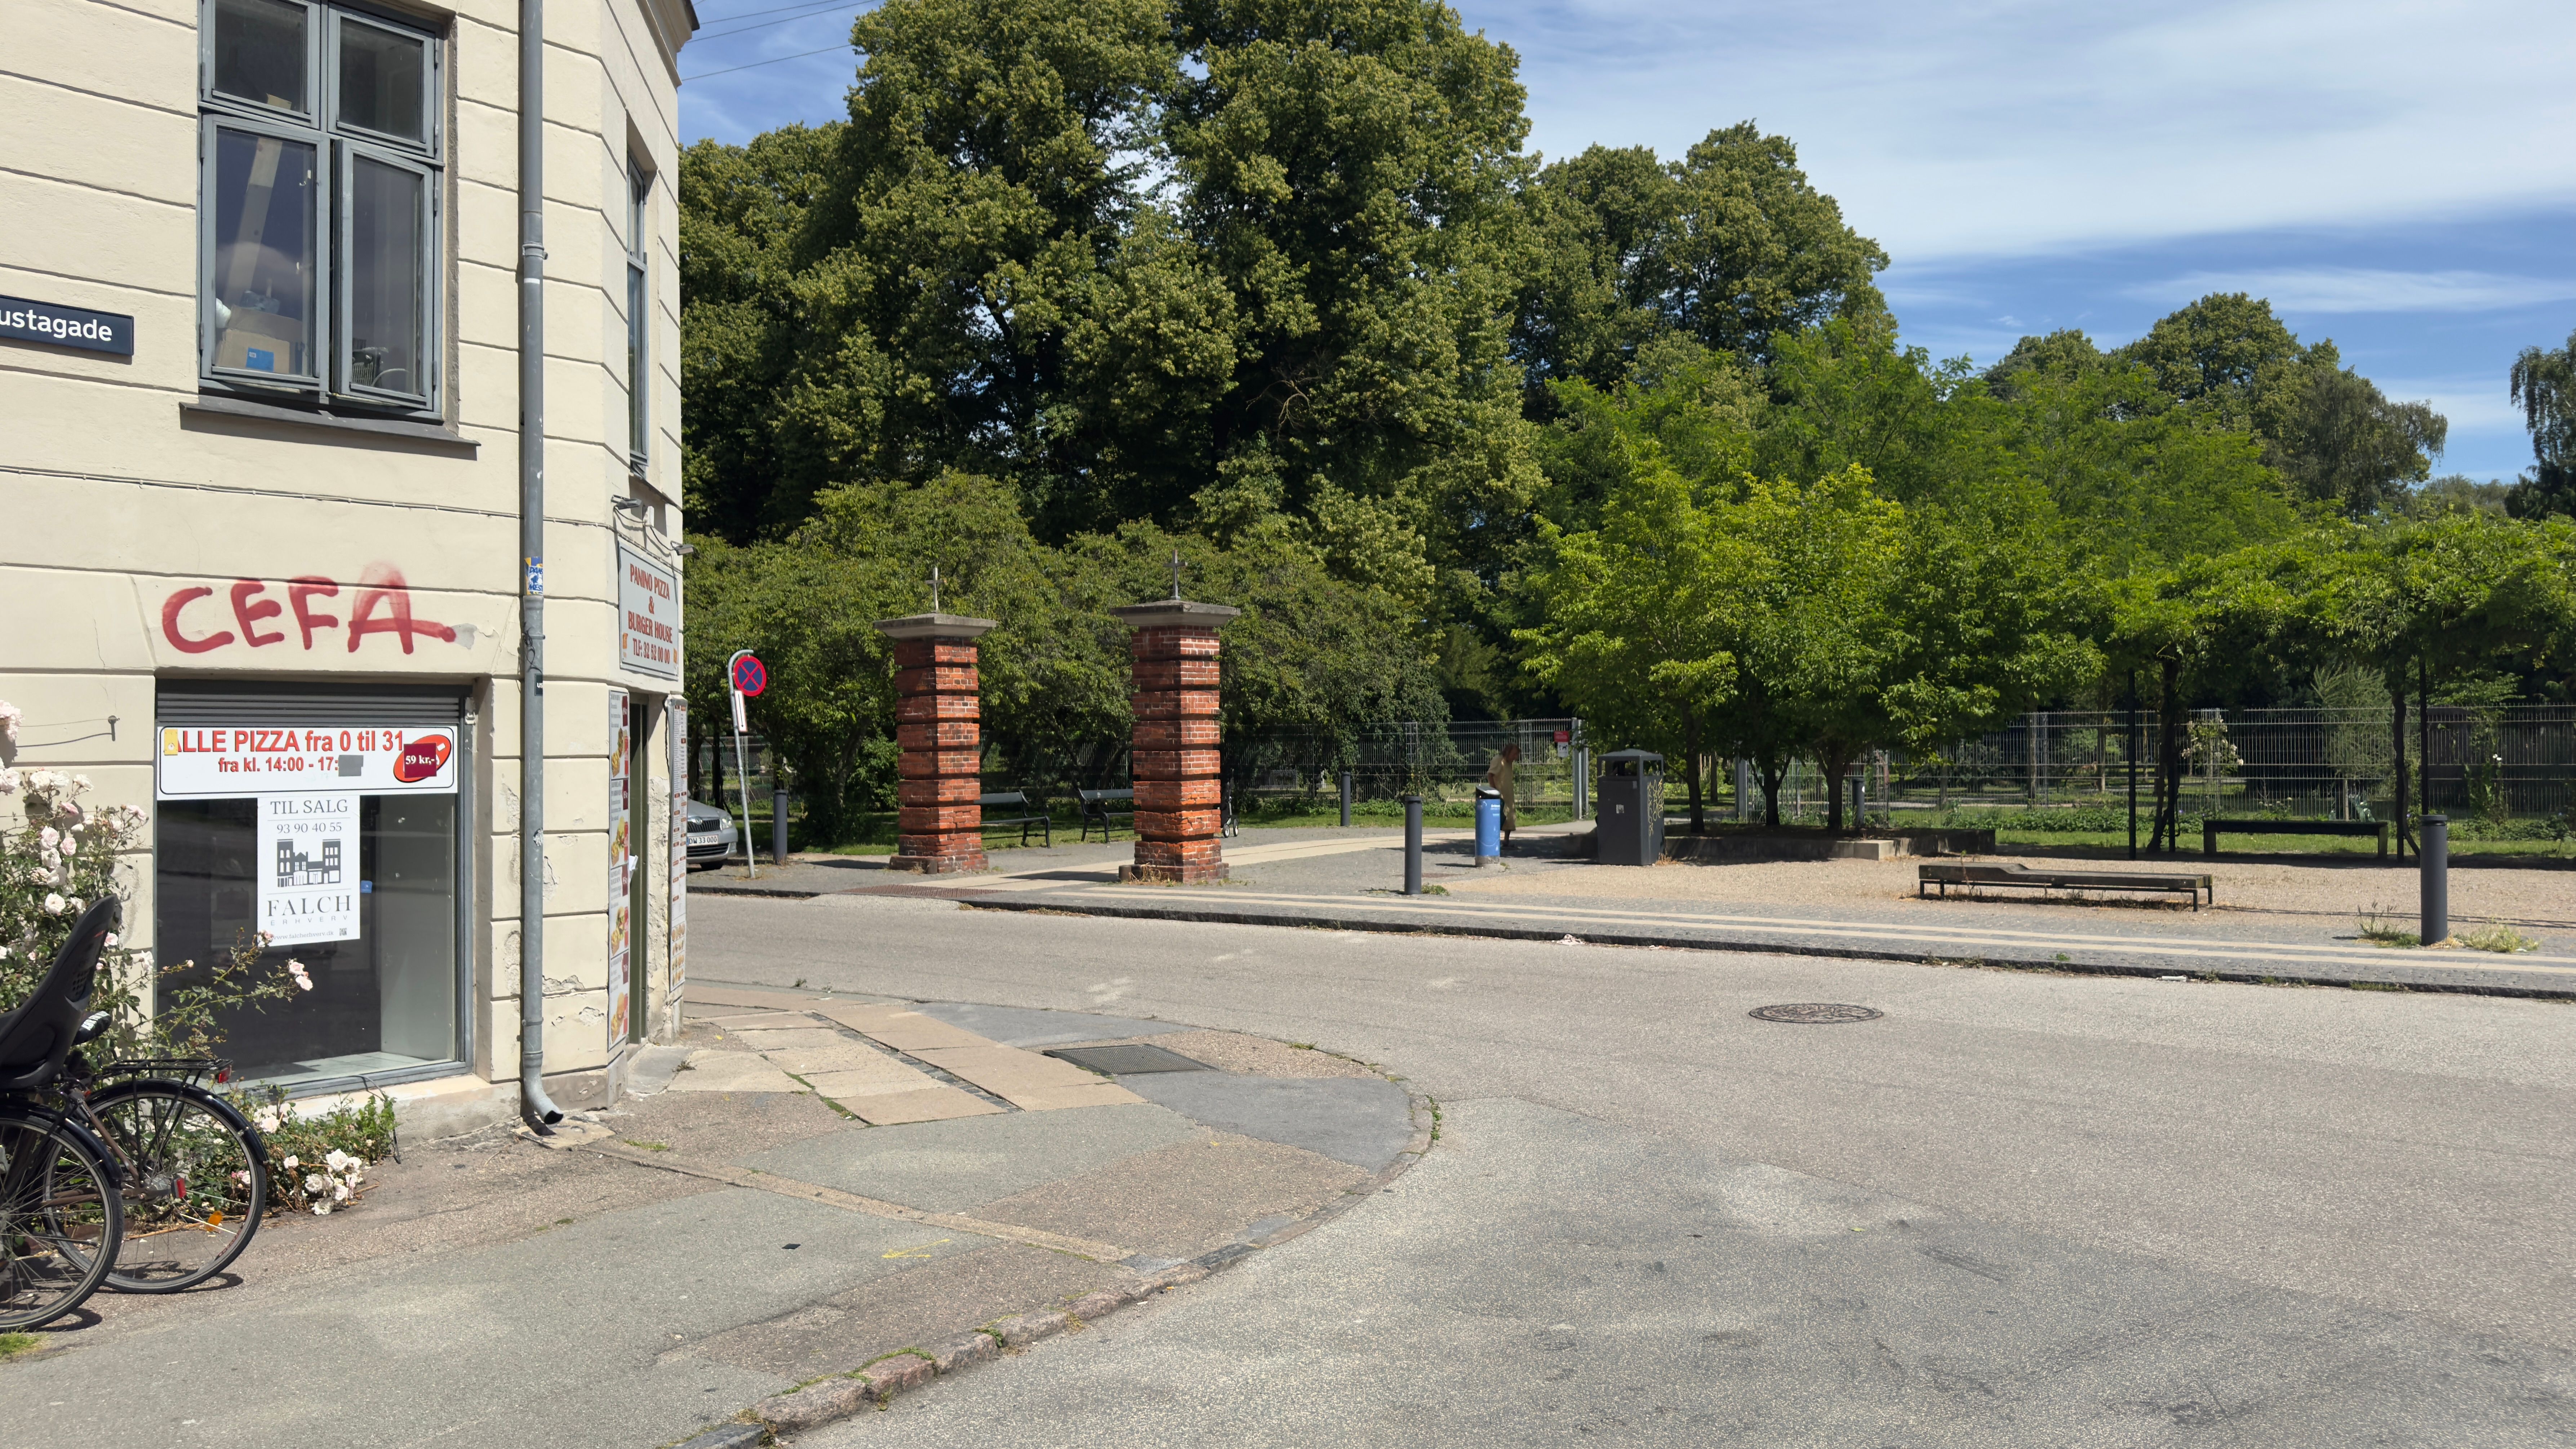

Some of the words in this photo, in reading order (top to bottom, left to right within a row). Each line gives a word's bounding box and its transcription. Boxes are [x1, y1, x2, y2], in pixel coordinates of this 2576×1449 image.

[0, 309, 112, 341] ustagade
[630, 563, 653, 591] PANINO
[654, 576, 670, 601] PIZZA
[162, 560, 457, 654] CEFA
[649, 596, 654, 614] &
[628, 610, 653, 637] BURGER
[655, 621, 672, 644] HOUSE
[633, 637, 642, 657] TLF:
[644, 641, 649, 659] 32
[651, 644, 657, 661] 52
[658, 646, 663, 663] 00
[664, 648, 670, 665] 00
[235, 730, 300, 752] PIZZA
[305, 730, 333, 752] fra
[339, 730, 351, 751] 0
[357, 730, 376, 751] til
[382, 730, 403, 751] 31
[218, 757, 239, 772] fra
[244, 757, 261, 772] kl.
[266, 757, 304, 772] 14:00
[318, 756, 338, 771] 17:
[405, 755, 416, 765] 59
[270, 801, 298, 814] TIL
[303, 799, 348, 814] SALG
[277, 824, 290, 834] 93
[294, 823, 308, 833] 90
[312, 822, 326, 832] 40
[329, 822, 342, 832] 55
[267, 895, 351, 917] FALCH
[271, 915, 347, 926] ERHVERV
